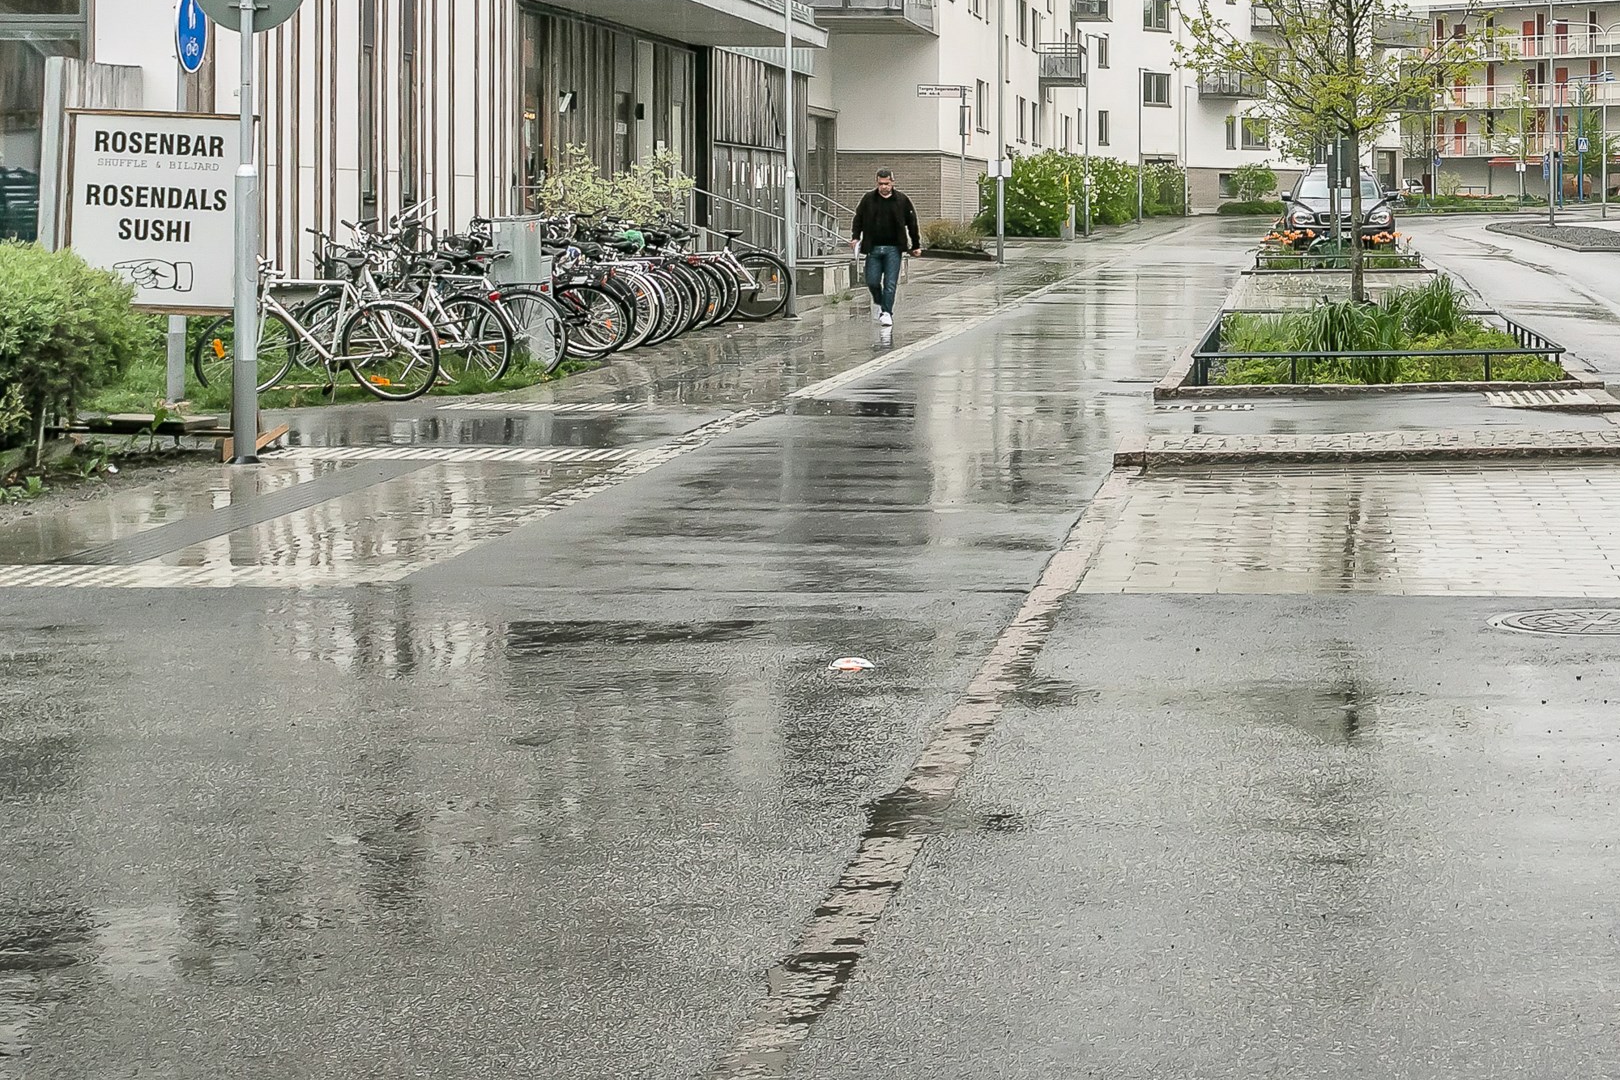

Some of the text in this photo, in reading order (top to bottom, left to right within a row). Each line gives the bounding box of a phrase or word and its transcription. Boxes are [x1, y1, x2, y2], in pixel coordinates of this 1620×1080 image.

[94, 130, 224, 157] ROSENBAR
[97, 158, 148, 168] SHUFFLE
[169, 160, 219, 171] BILJARD
[86, 183, 227, 211] ROSENDALS
[118, 218, 191, 242] SUSHI
